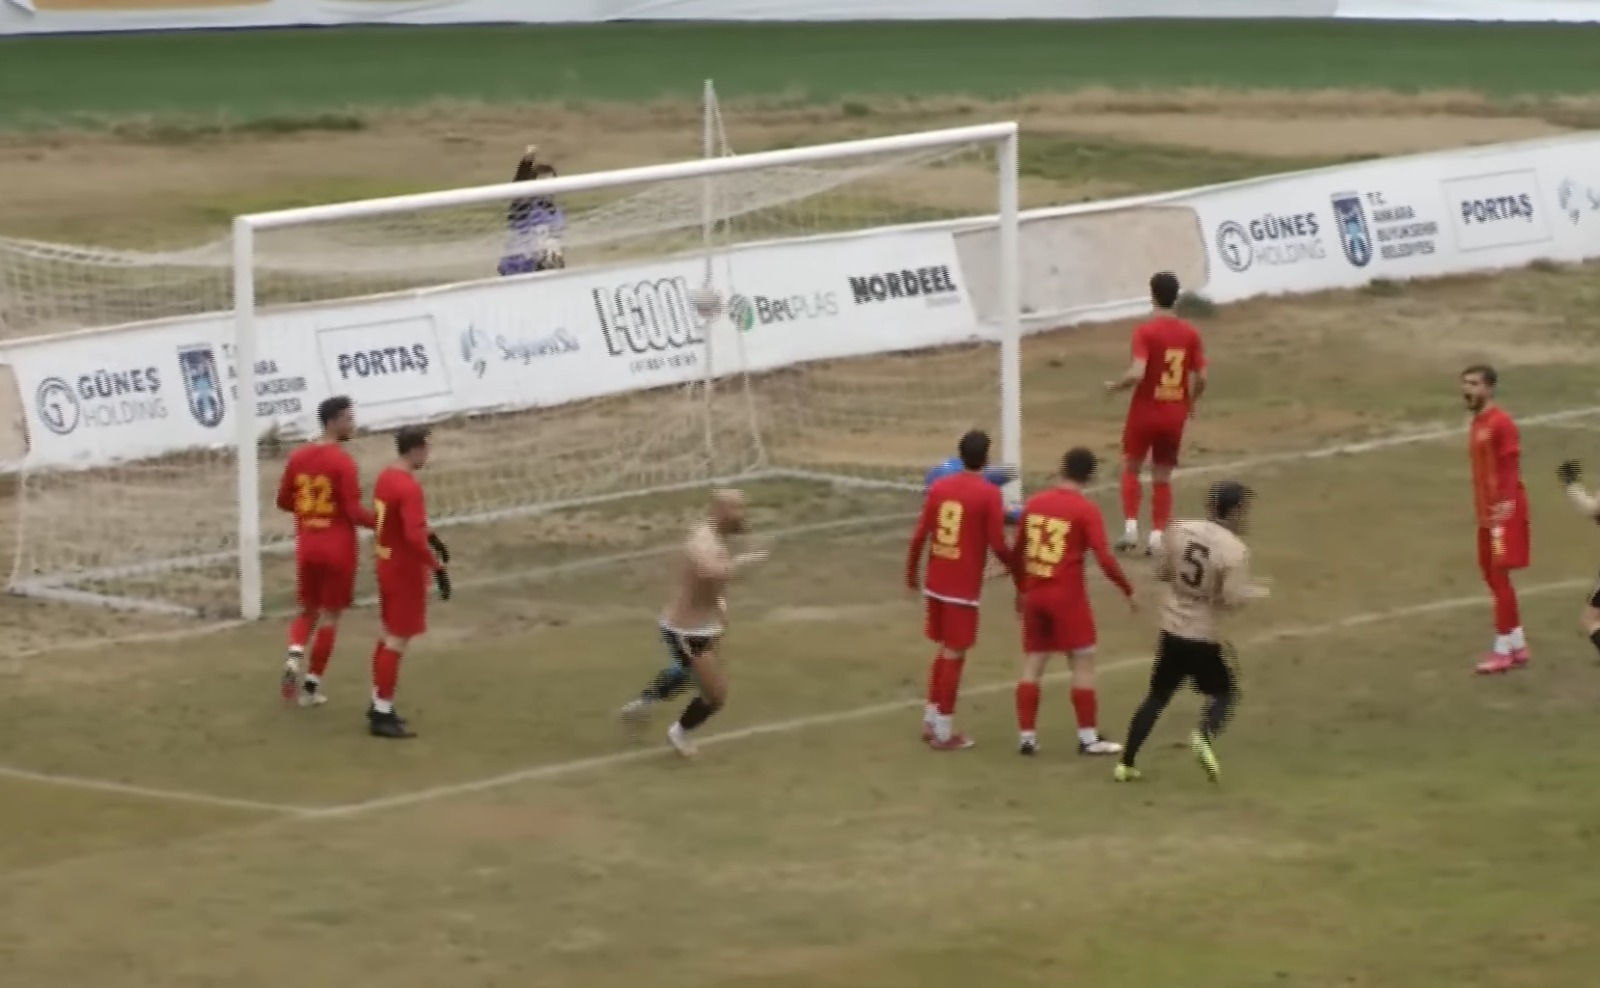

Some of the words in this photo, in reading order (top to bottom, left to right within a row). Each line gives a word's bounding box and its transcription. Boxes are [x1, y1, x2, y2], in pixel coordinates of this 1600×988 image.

[1249, 212, 1321, 243] GÜNEŞ
[337, 342, 430, 379] PORTAŞ
[1161, 349, 1186, 387] 3
[77, 367, 161, 400] GÜNEŞ
[936, 500, 964, 545] 9
[1180, 541, 1210, 587] 5
